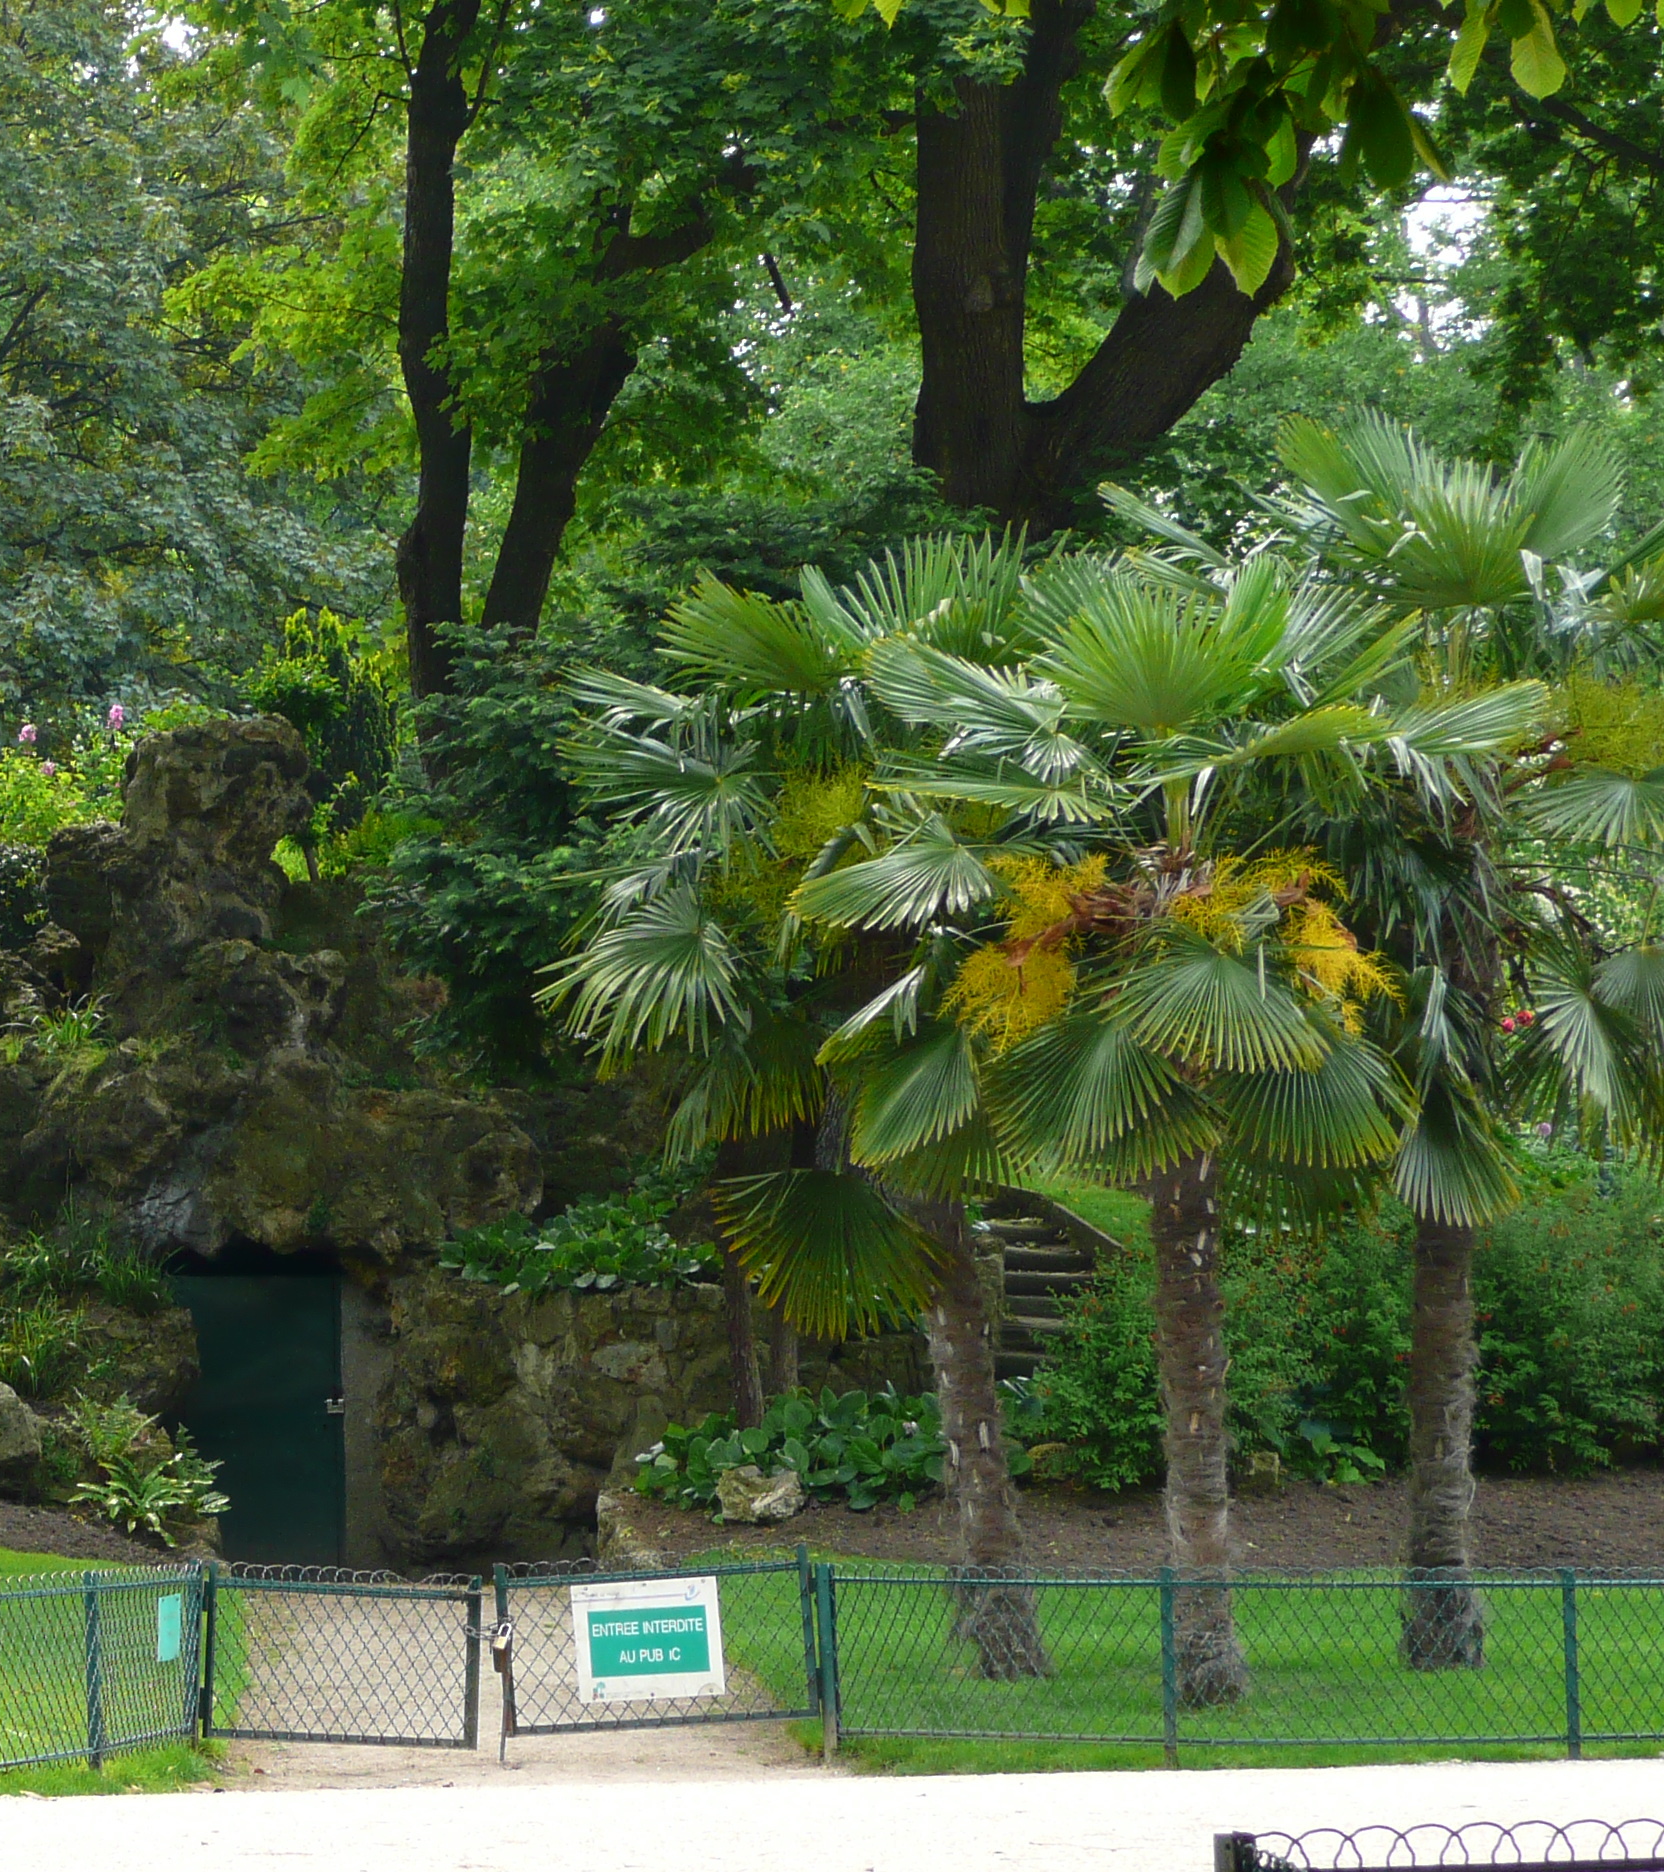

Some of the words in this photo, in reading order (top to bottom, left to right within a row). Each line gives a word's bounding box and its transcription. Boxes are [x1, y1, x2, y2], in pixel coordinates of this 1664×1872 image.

[592, 1621, 639, 1637] ENTREE
[642, 1617, 704, 1634] INTERDITE
[619, 1650, 636, 1663] AU
[639, 1646, 681, 1662] PUBIC
